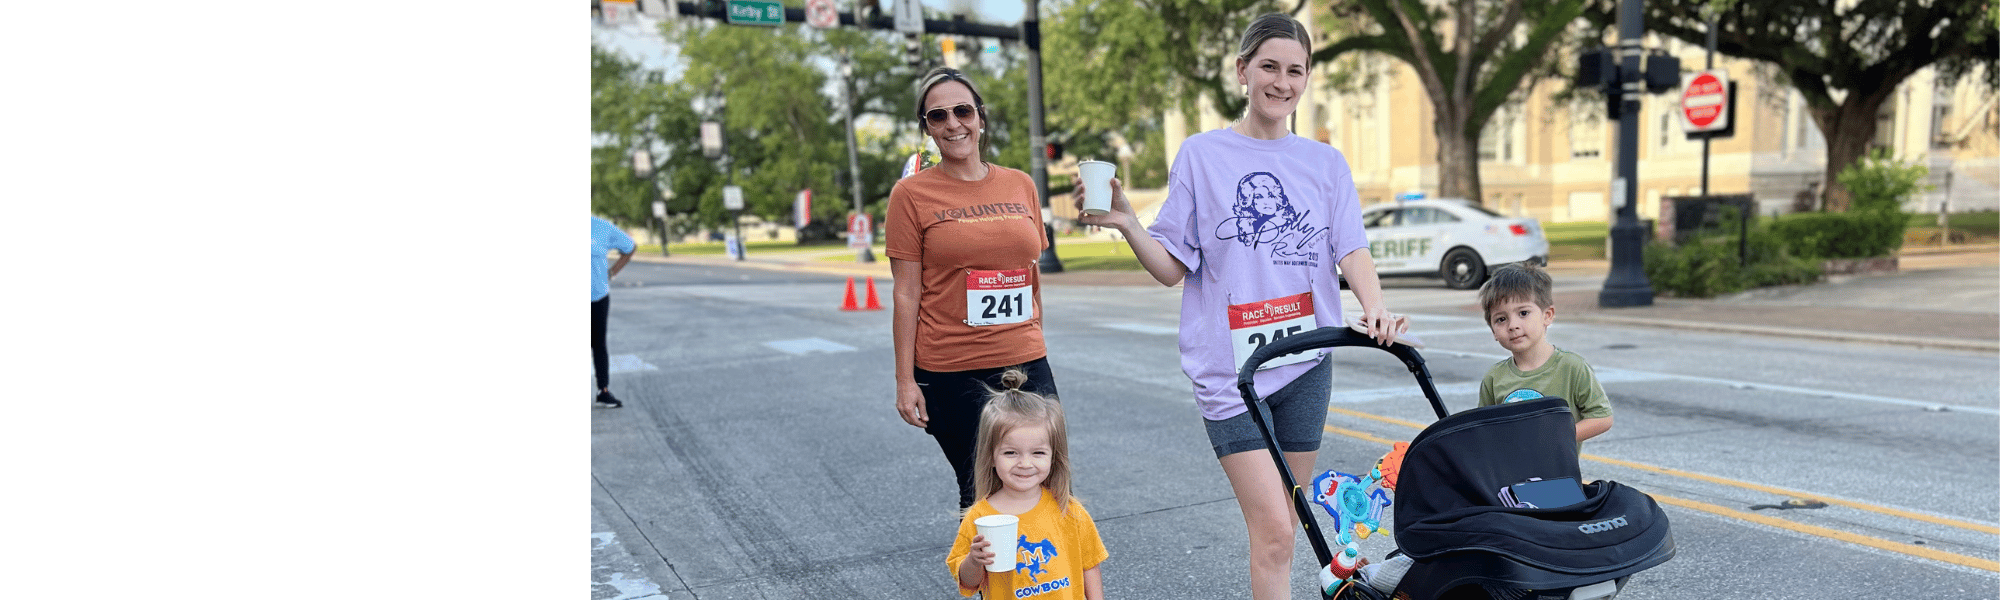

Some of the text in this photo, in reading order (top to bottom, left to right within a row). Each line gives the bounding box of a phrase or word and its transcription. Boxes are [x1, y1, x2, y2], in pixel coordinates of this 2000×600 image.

[1370, 237, 1433, 259] ERIFF
[979, 277, 998, 285] RACE
[1005, 274, 1026, 284] RESULT
[981, 293, 1023, 319] 241
[1242, 309, 1265, 321] RACE
[1274, 302, 1301, 315] RESULT
[1021, 547, 1047, 567] M
[1015, 576, 1070, 599] COWBOYS
